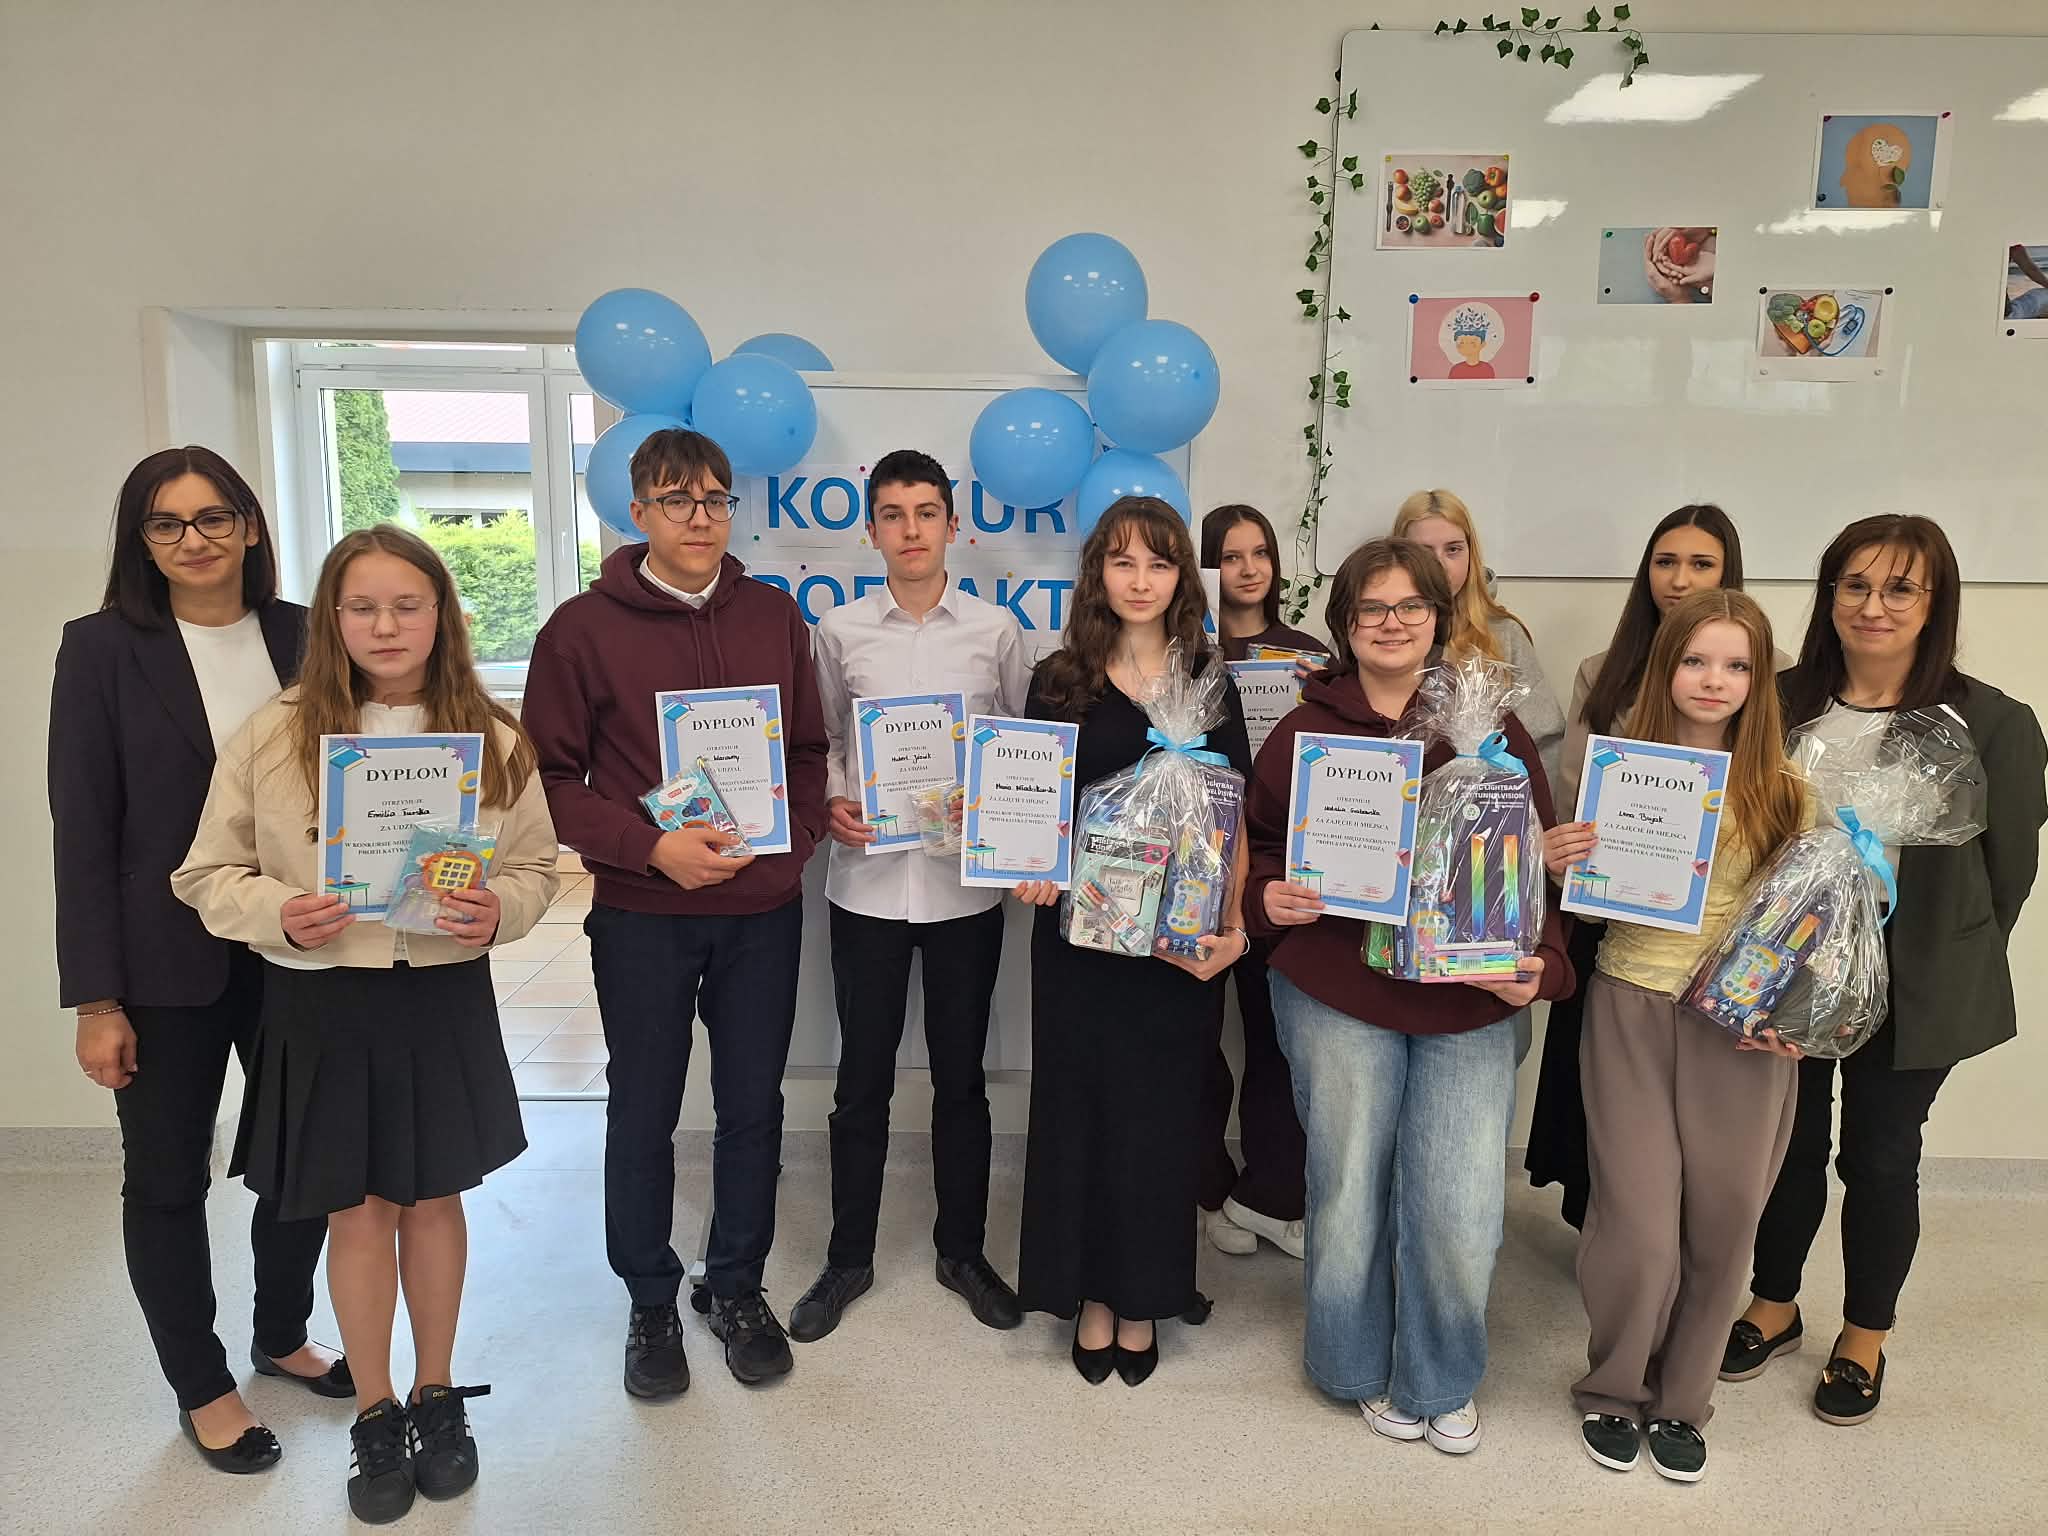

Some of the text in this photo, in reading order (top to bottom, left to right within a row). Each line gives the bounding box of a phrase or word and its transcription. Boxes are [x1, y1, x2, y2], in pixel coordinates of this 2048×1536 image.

[767, 476, 1066, 534] KOUR
[1239, 685, 1289, 695] DYPLOM
[693, 716, 755, 730] DYPLOM
[885, 719, 942, 734] DYPLOM
[997, 747, 1053, 761] DYPLOM
[366, 767, 449, 781] DYPLOM
[1326, 766, 1392, 783] DYPLOM
[1621, 771, 1694, 793] DYPLOM
[367, 809, 396, 818] Emilia
